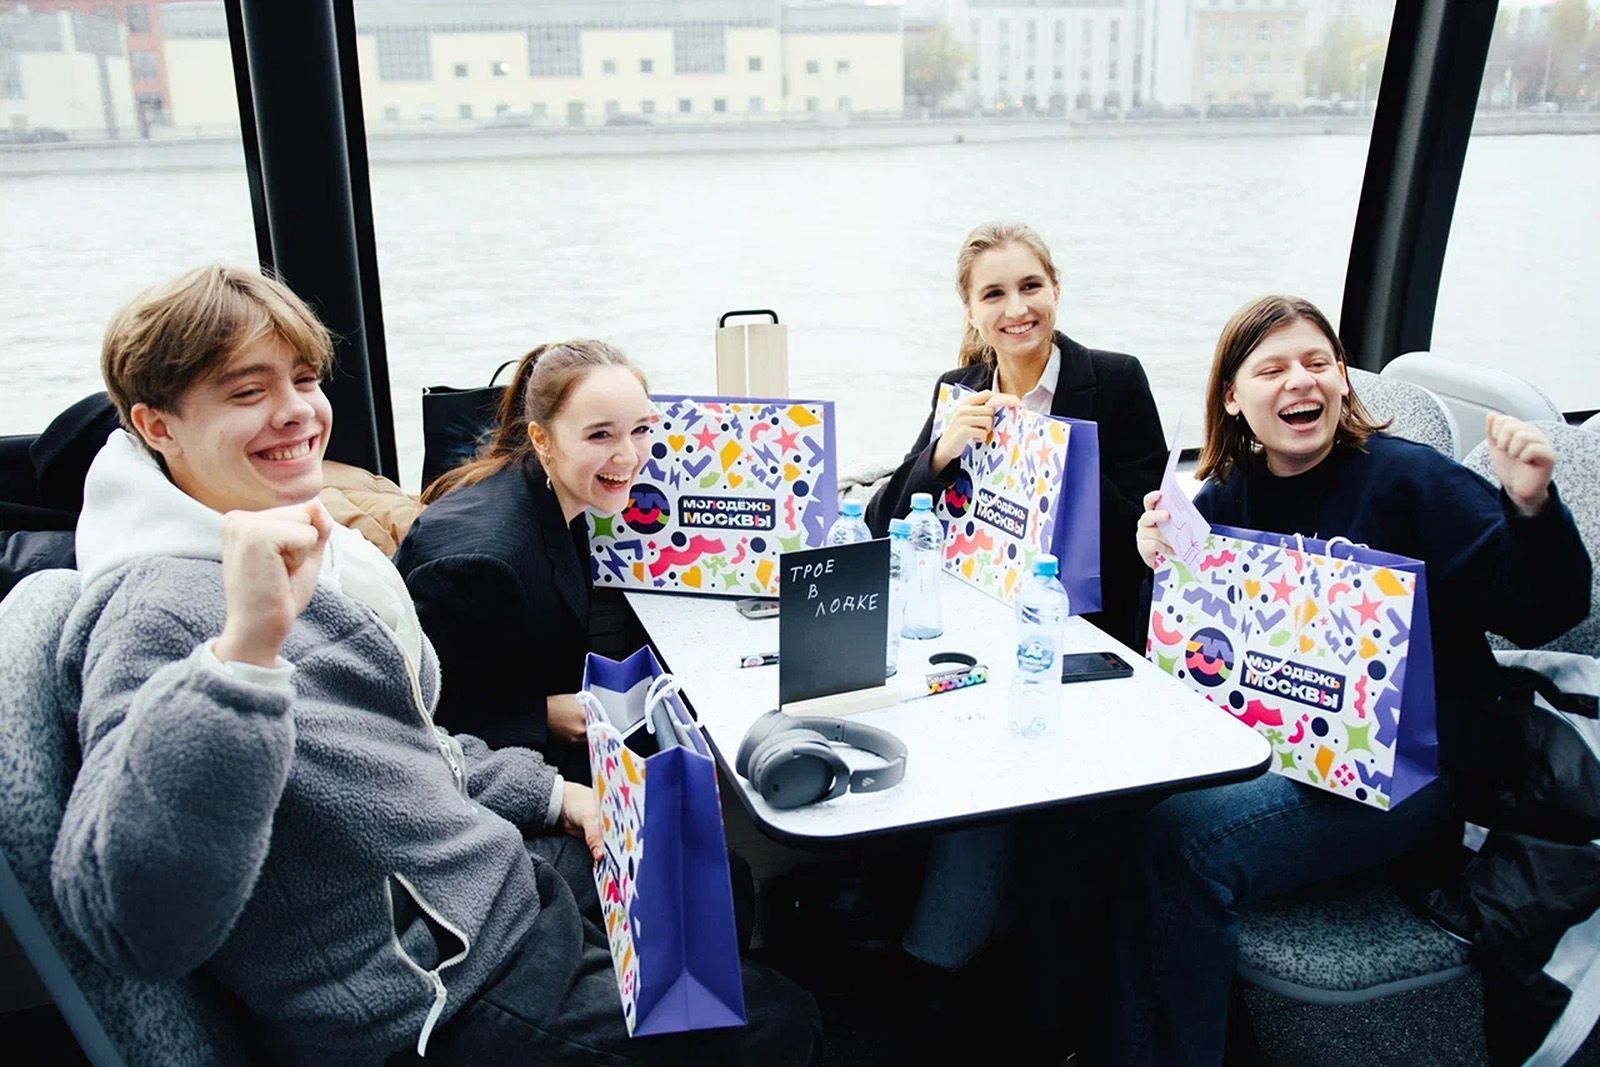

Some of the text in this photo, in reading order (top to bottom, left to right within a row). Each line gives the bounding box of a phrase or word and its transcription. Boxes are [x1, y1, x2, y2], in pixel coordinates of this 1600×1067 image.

[683, 511, 771, 527] МОСКВЫ
[790, 559, 835, 582] ТРОЕ
[807, 584, 819, 600] В
[815, 593, 879, 618] ЛОДКЕ
[1245, 669, 1339, 709] МОСКВЫ
